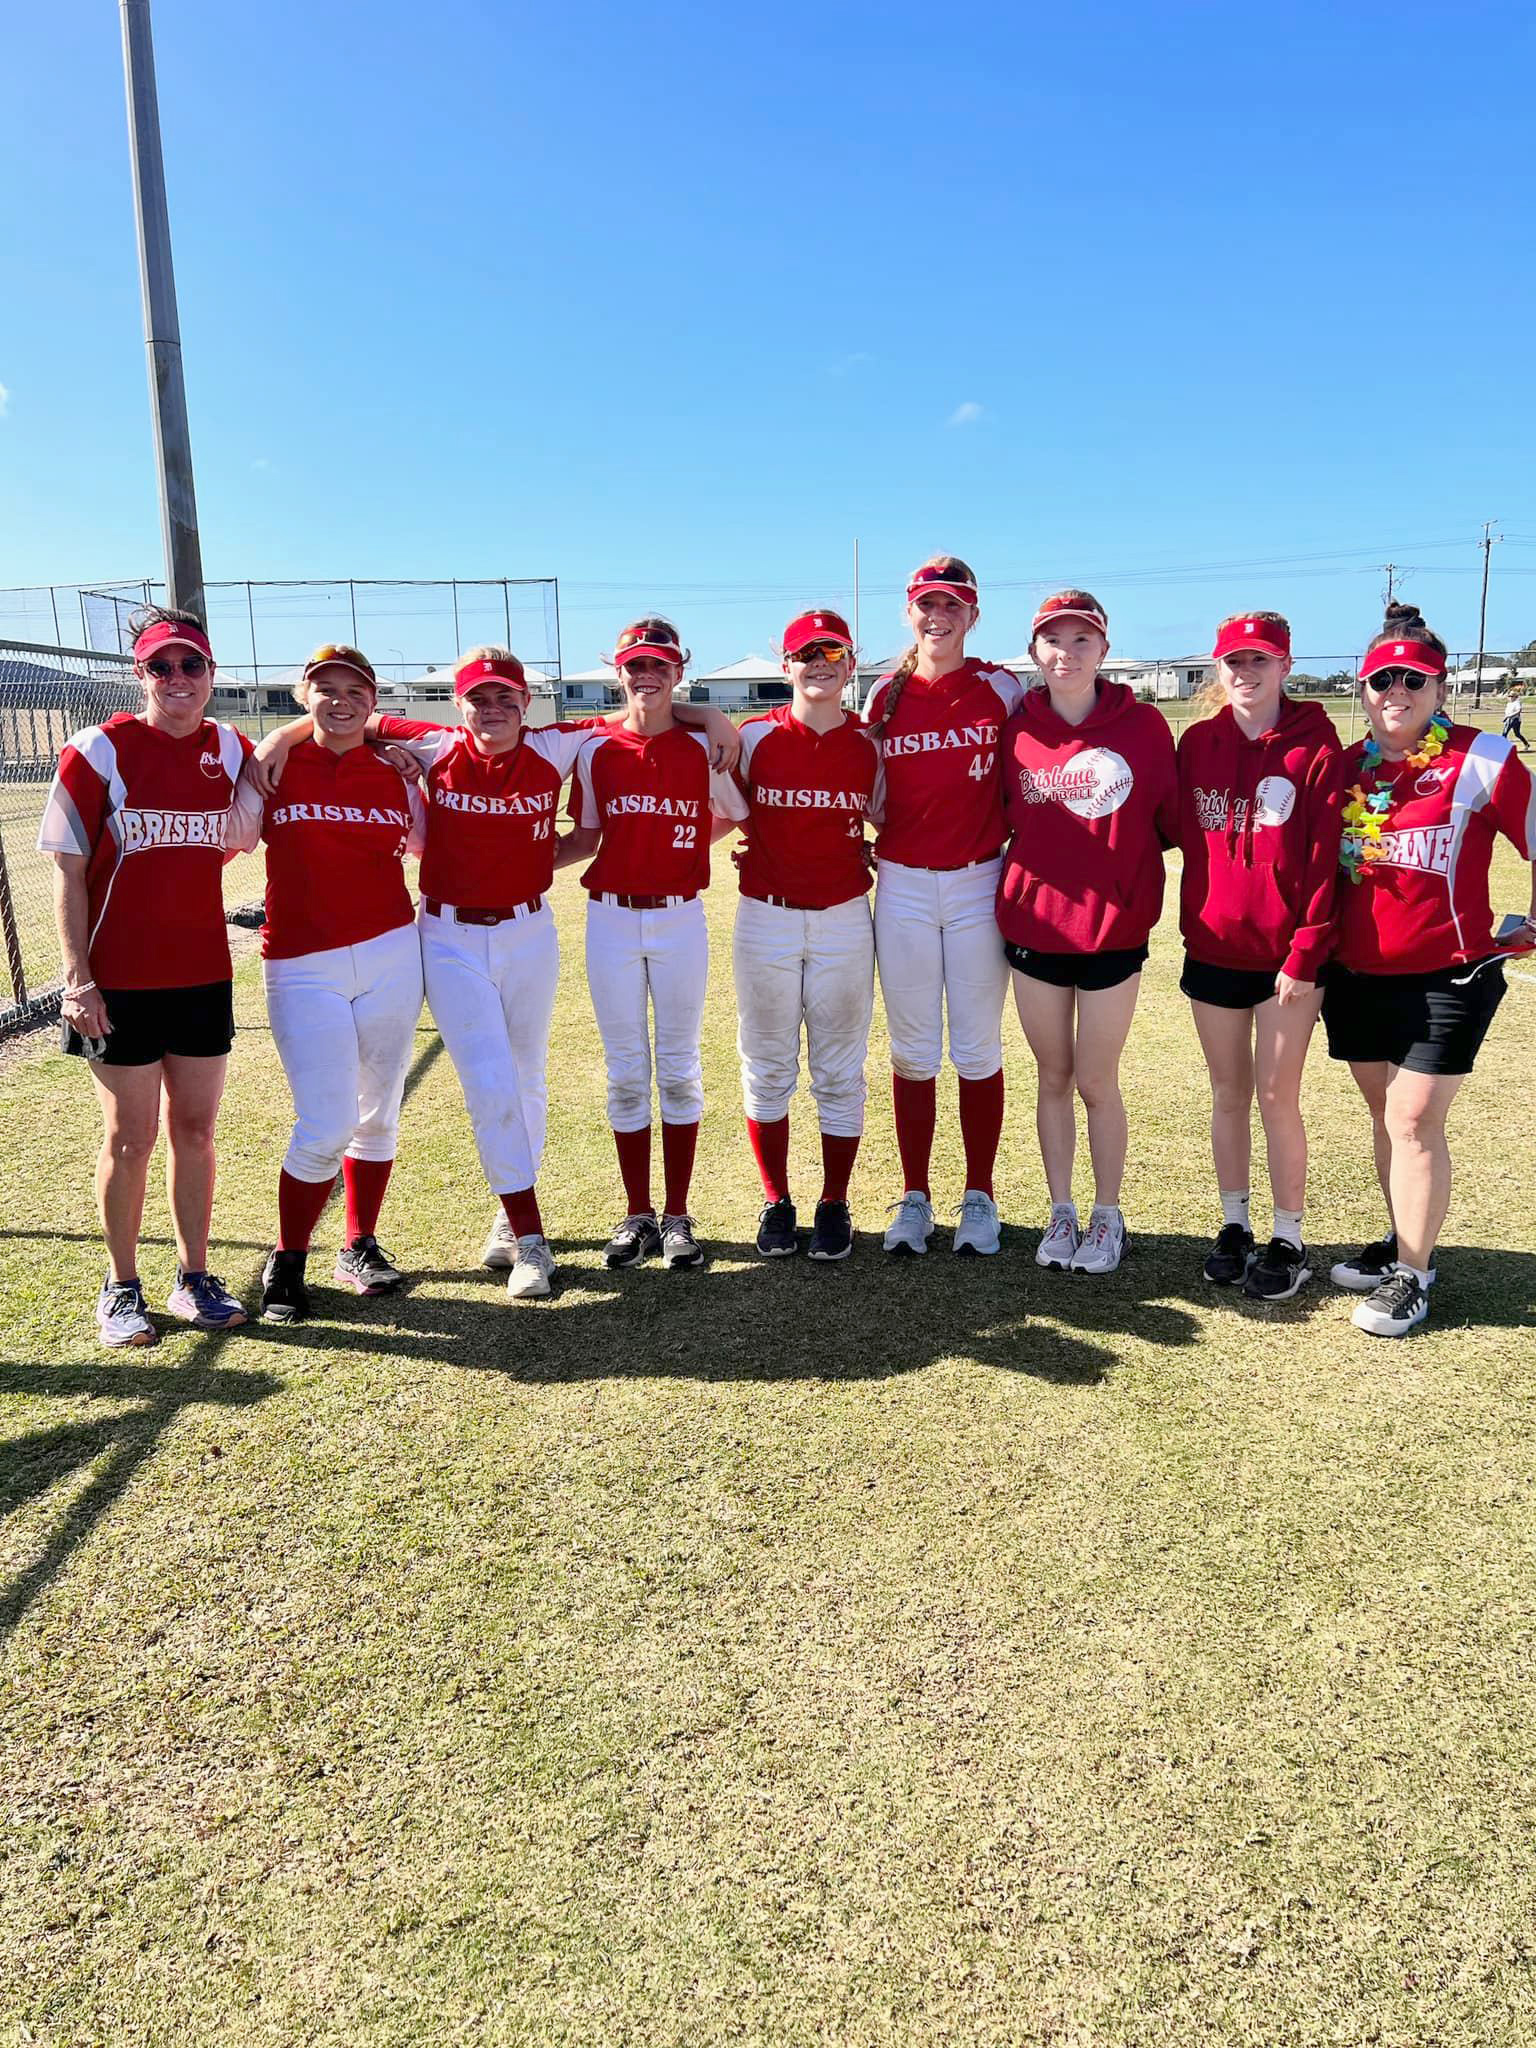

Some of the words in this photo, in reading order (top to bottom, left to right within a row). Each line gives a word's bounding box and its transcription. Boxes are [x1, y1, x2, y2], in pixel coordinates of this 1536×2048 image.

[1019, 765, 1100, 795] Brisbane
[436, 788, 553, 814] BRISBANE
[1024, 787, 1094, 804] SOFTBALL
[672, 824, 696, 848] 22
